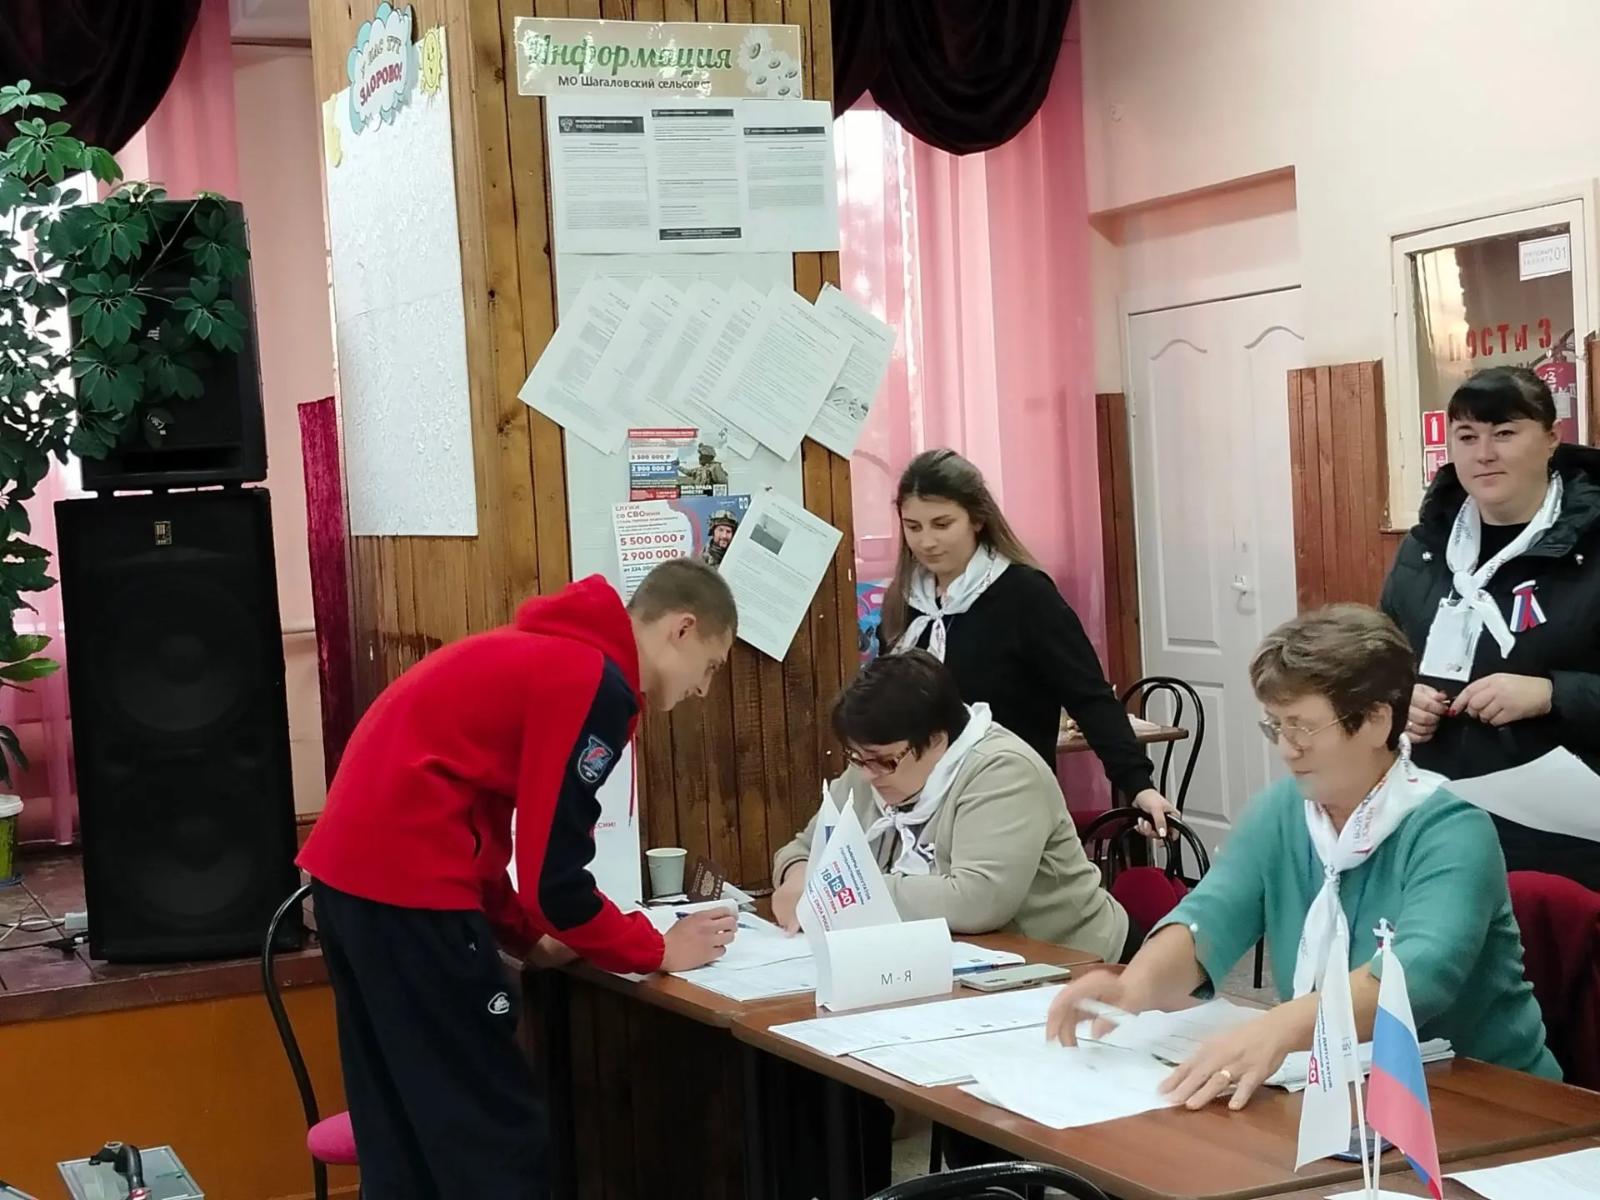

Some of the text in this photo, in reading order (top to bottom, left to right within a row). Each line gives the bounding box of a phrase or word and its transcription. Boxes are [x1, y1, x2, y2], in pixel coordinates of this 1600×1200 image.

[558, 76, 578, 87] МО
[581, 77, 655, 89] Шагаловский
[620, 537, 627, 546] 5
[630, 535, 652, 545] 500
[655, 534, 678, 543] 000
[622, 553, 629, 562] 2
[631, 551, 653, 561] 900
[656, 549, 678, 559] 000
[821, 868, 854, 906] 18 19 20
[881, 973, 893, 985] М
[904, 970, 912, 982] Я
